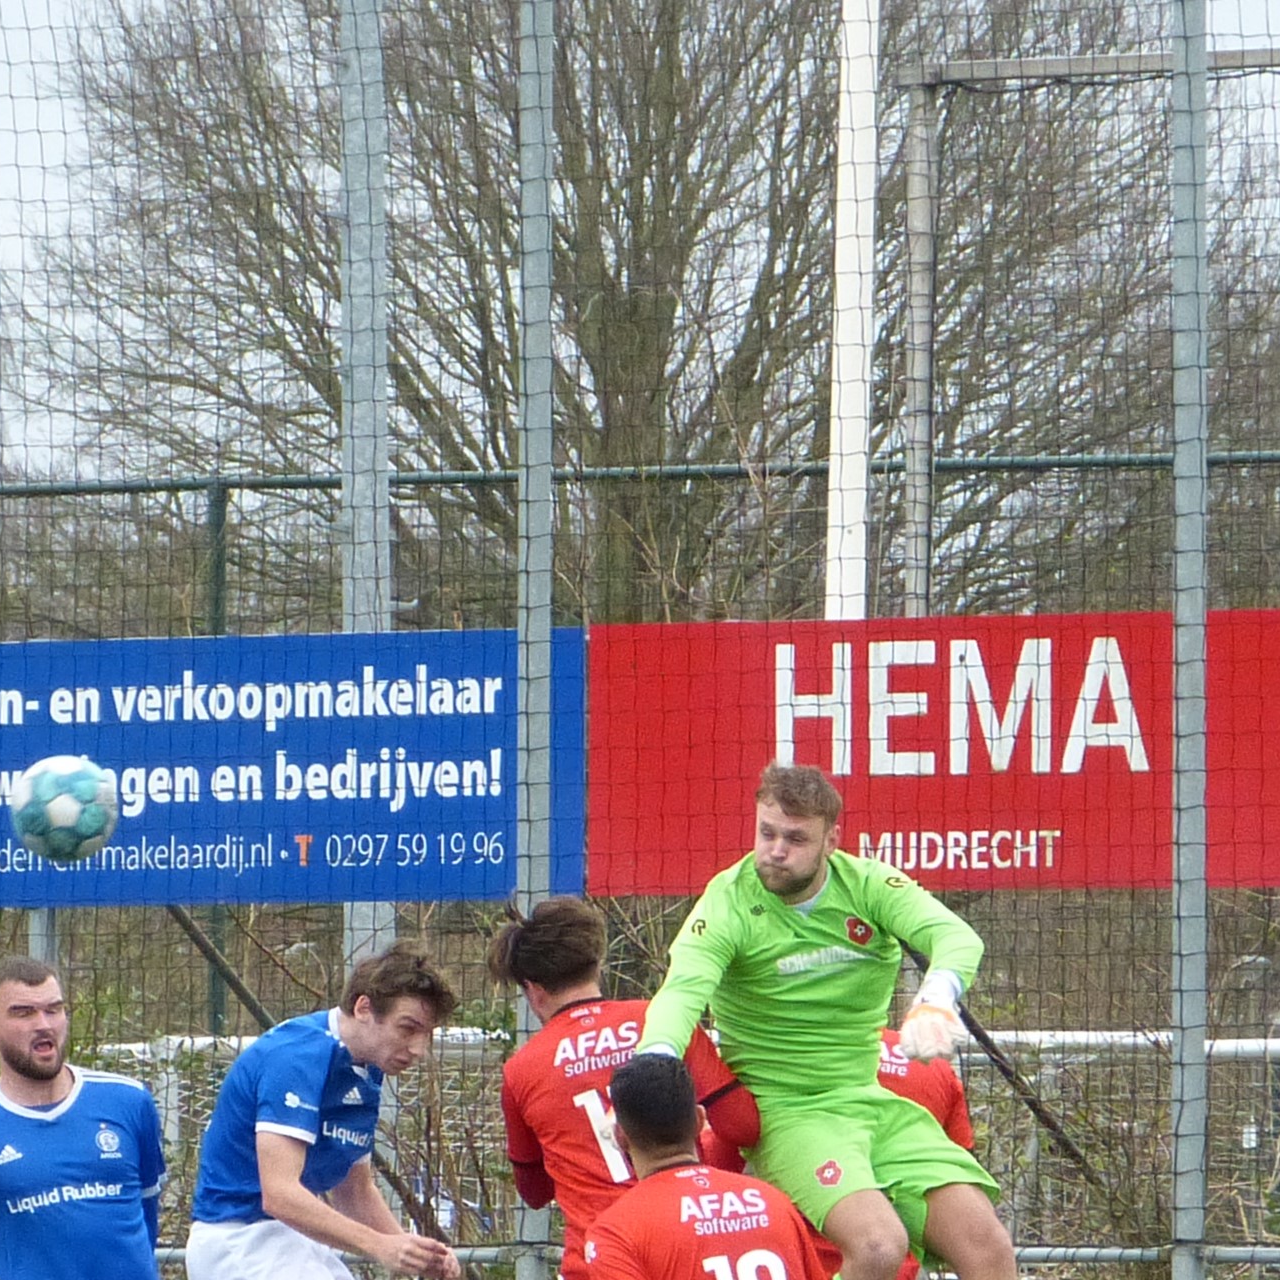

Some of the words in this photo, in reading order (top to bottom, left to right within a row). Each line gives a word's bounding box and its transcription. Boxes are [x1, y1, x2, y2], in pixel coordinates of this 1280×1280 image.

[49, 686, 101, 724] en
[111, 664, 503, 732] verkoopmakelaar
[775, 637, 1150, 776] HEMA
[211, 763, 263, 802] en
[275, 747, 503, 812] bedrijven!
[294, 835, 313, 866] T
[326, 834, 389, 867] 0297
[397, 833, 428, 866] 59
[437, 832, 466, 865] 19
[473, 831, 505, 865] 96
[859, 829, 1061, 871] MIJDRECHT
[554, 1021, 639, 1067] AFAS
[6, 1187, 60, 1214] Liquid
[61, 1181, 123, 1202] Rubber
[680, 1188, 767, 1223] AFAS
[694, 1213, 769, 1236] software
